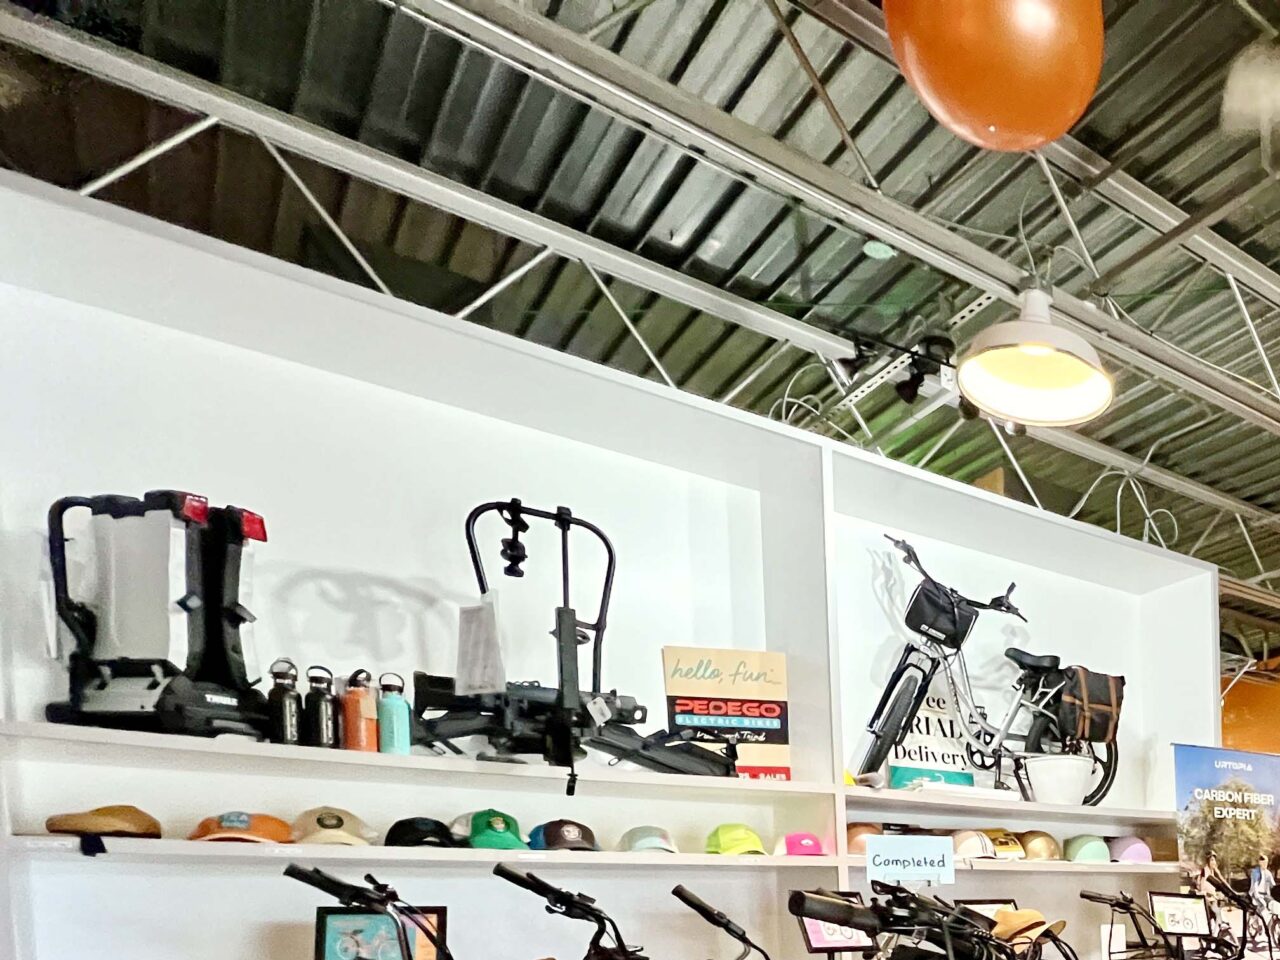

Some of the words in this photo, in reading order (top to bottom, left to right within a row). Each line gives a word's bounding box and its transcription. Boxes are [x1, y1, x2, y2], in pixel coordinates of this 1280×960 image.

[670, 658, 723, 684] hello,
[675, 699, 781, 718] PEDEGO
[925, 695, 946, 710] ee
[677, 715, 738, 727] ELECTRIC
[743, 718, 780, 728] BIKES
[909, 715, 963, 740] RIAL
[893, 743, 968, 771] Delivery
[1214, 760, 1253, 772] URTOPIA
[1194, 788, 1243, 803] CARBON
[1243, 792, 1275, 806] FIBER
[1213, 806, 1257, 820] EXPERT
[872, 853, 946, 869] Completed
